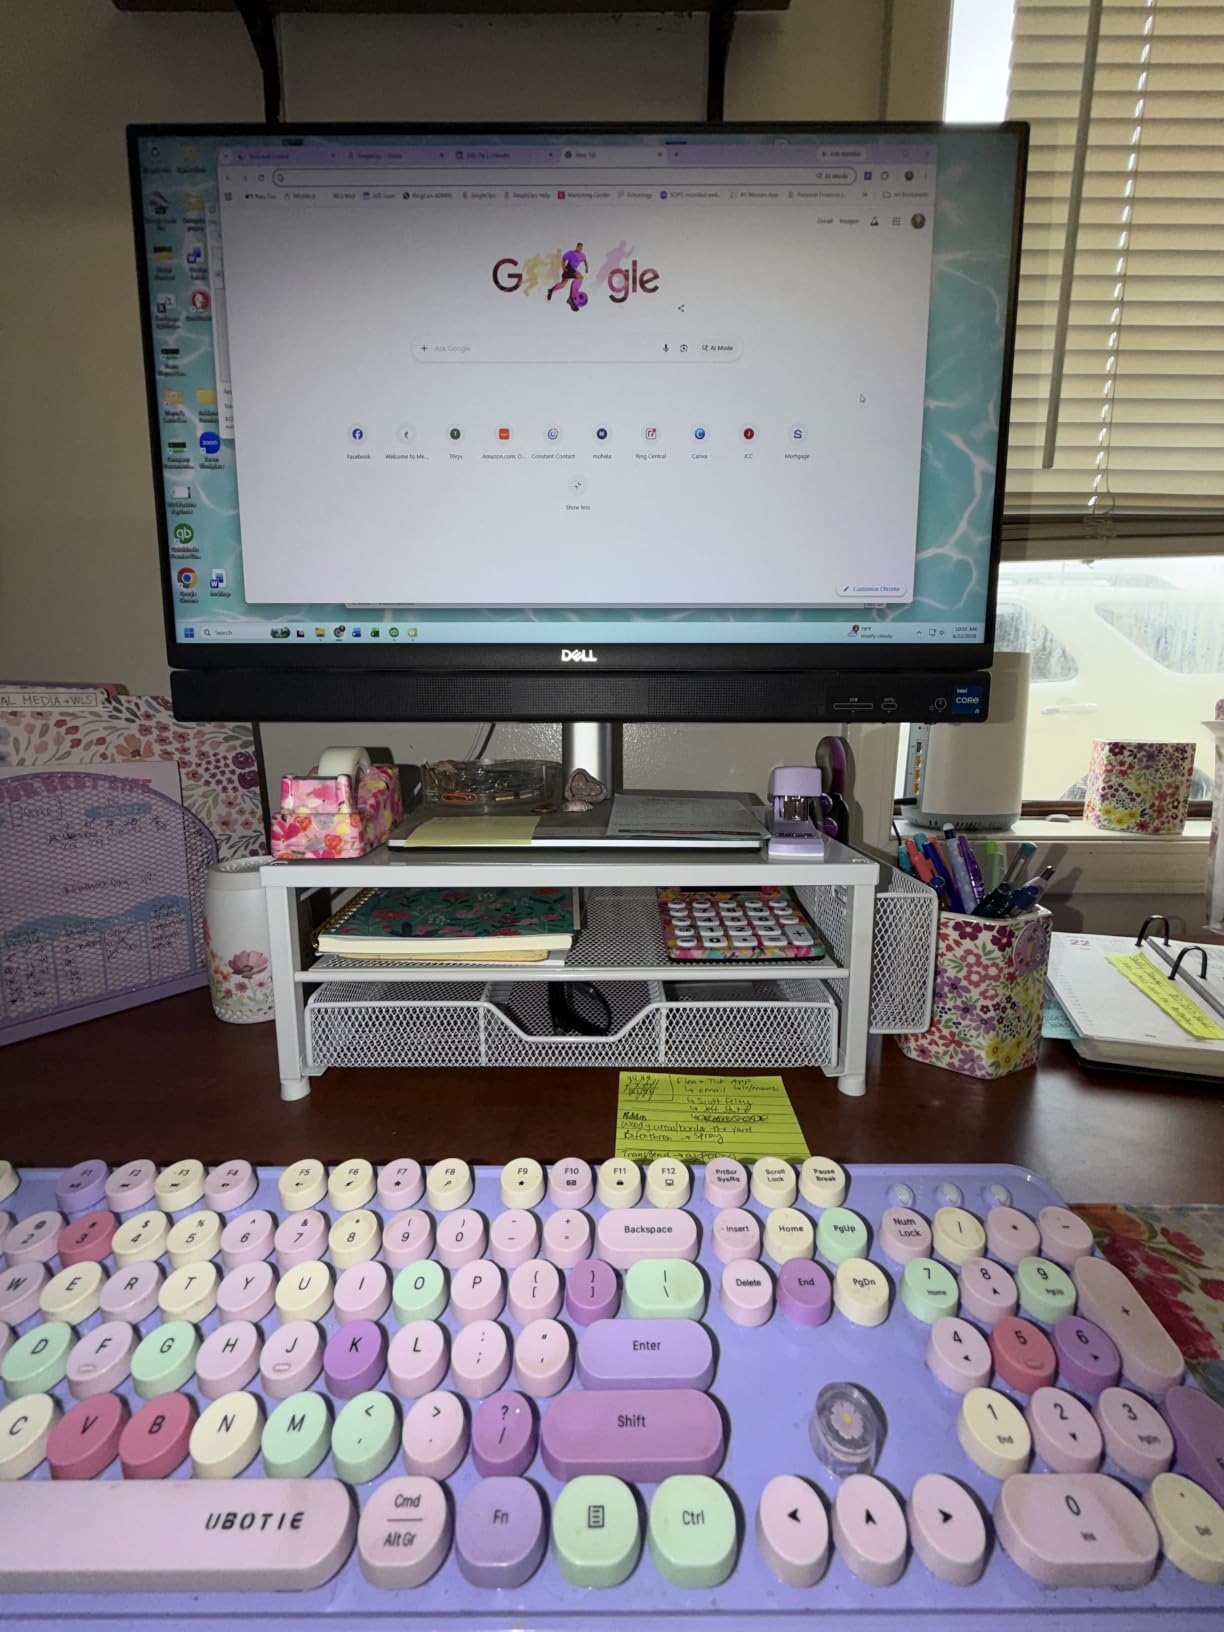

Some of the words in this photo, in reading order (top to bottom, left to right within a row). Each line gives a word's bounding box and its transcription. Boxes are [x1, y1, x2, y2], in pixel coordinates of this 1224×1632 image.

[635, 453, 647, 461] Ring
[784, 453, 810, 461] Mortgage
[561, 649, 598, 662] DELL
[22, 695, 60, 706] MEDIA
[81, 1169, 93, 1177] F1
[129, 1169, 142, 1177] F2
[178, 1169, 190, 1177] F3
[299, 1168, 310, 1176] F5
[518, 1167, 528, 1175] F9
[564, 1167, 579, 1175] F10
[833, 1224, 856, 1233] PgUp
[893, 1218, 916, 1226] Num
[624, 1225, 672, 1234] Backspace
[899, 1228, 922, 1237] Lock
[21, 1233, 34, 1244] 2
[76, 1233, 88, 1244] 3
[131, 1233, 142, 1243] 4
[186, 1233, 197, 1243] 5
[240, 1232, 250, 1243] 6
[293, 1232, 303, 1243] 7
[346, 1232, 356, 1242] 8
[401, 1232, 410, 1242] 9
[923, 1267, 932, 1279] 7
[980, 1267, 991, 1280] 8
[1037, 1267, 1049, 1280] 9
[6, 1277, 27, 1291] W
[65, 1277, 82, 1291] E
[124, 1277, 139, 1290] R
[184, 1277, 197, 1290] T
[243, 1277, 255, 1290] Y
[298, 1277, 311, 1290] U
[472, 1276, 482, 1289] P
[736, 1278, 761, 1287] Delete
[798, 1278, 815, 1286] End
[852, 1278, 876, 1287] PgDn
[953, 1330, 963, 1344] 4
[1015, 1330, 1028, 1345] 5
[1076, 1330, 1089, 1344] 6
[30, 1338, 48, 1355] D
[96, 1338, 112, 1354] F
[160, 1338, 175, 1353] G
[222, 1338, 239, 1353] H
[285, 1337, 298, 1353] J
[350, 1337, 363, 1352] K
[413, 1337, 421, 1352] L
[633, 1340, 661, 1351] Enter
[364, 1405, 374, 1417] <
[432, 1406, 441, 1418] >
[501, 1405, 509, 1420] ?
[987, 1404, 998, 1420] 1
[1053, 1403, 1068, 1420] 2
[1122, 1403, 1138, 1421] 3
[9, 1416, 28, 1435] C
[80, 1416, 98, 1435] V
[148, 1415, 166, 1435] B
[217, 1414, 236, 1433] N
[286, 1414, 306, 1432] M
[617, 1415, 646, 1428] Shift
[394, 1494, 421, 1508] Cmd
[1065, 1495, 1081, 1516] 0
[205, 1511, 305, 1531] UBOTIE
[493, 1509, 509, 1524] Fn
[682, 1511, 705, 1526] Ctrl
